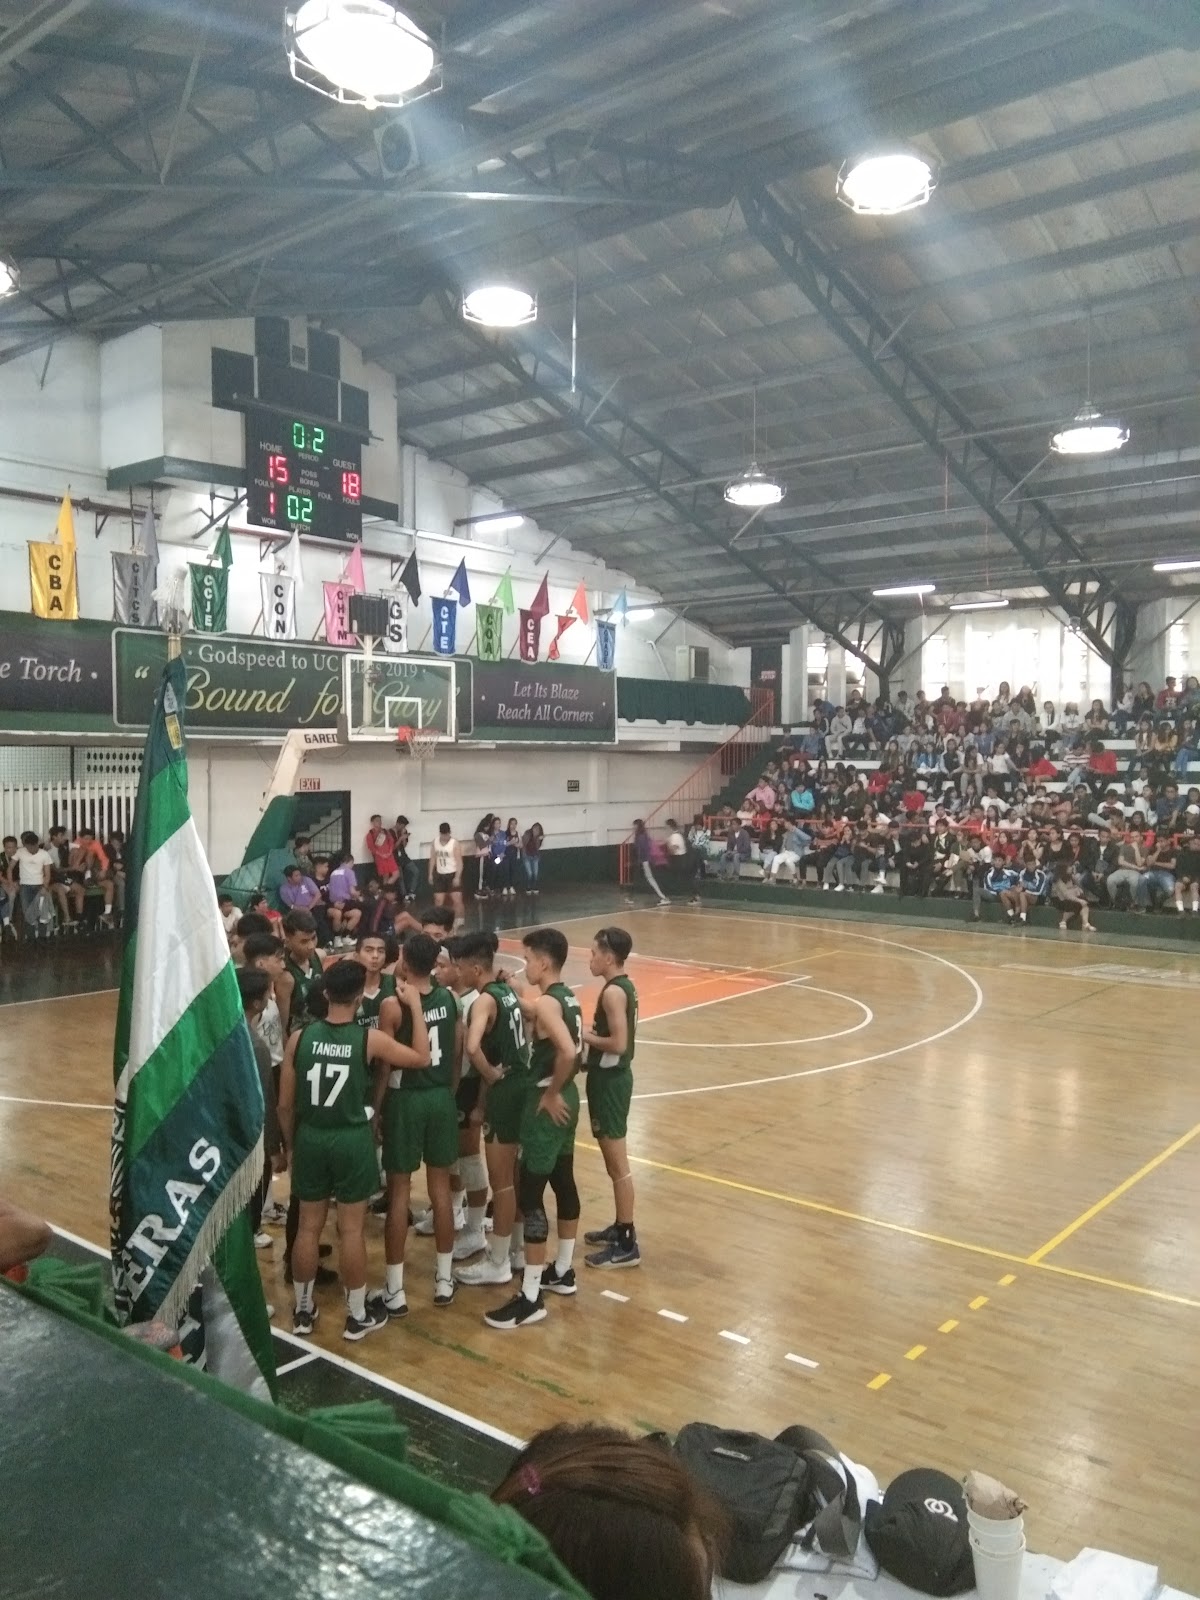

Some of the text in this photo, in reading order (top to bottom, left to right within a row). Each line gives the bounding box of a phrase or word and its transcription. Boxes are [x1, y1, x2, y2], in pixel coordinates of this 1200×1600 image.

[260, 442, 283, 454] HOME
[298, 452, 319, 463] PERIOD
[269, 455, 289, 483] 15
[332, 458, 356, 471] GUEST
[254, 478, 275, 489] FOULS
[288, 485, 311, 496] PLAYER
[299, 478, 320, 488] BONUS
[317, 491, 333, 501] FOUL
[342, 472, 360, 497] 18
[287, 495, 313, 522] 02
[342, 497, 361, 506] FOULS
[261, 517, 277, 526] WON
[345, 532, 359, 540] WON
[48, 554, 63, 612] CBA
[131, 562, 140, 624] CITCS
[203, 574, 213, 627] CCJE
[273, 584, 286, 634] CON
[336, 590, 348, 640] CHTM
[389, 601, 403, 643] GS
[440, 606, 449, 650] CTE
[484, 614, 494, 654] COA
[526, 618, 535, 660] CEA
[19, 656, 82, 683] Torch
[198, 643, 287, 672] Godspeed
[292, 654, 308, 670] to
[313, 653, 340, 672] UC
[386, 663, 418, 679] 2019
[298, 676, 345, 724] fo
[513, 681, 579, 700] Let Its Blaze
[497, 703, 594, 723] Reach All Corners
[300, 778, 320, 790] EXIT
[509, 1008, 526, 1050] 12
[311, 1041, 352, 1059] TANGKIB
[306, 1062, 350, 1108] 17
